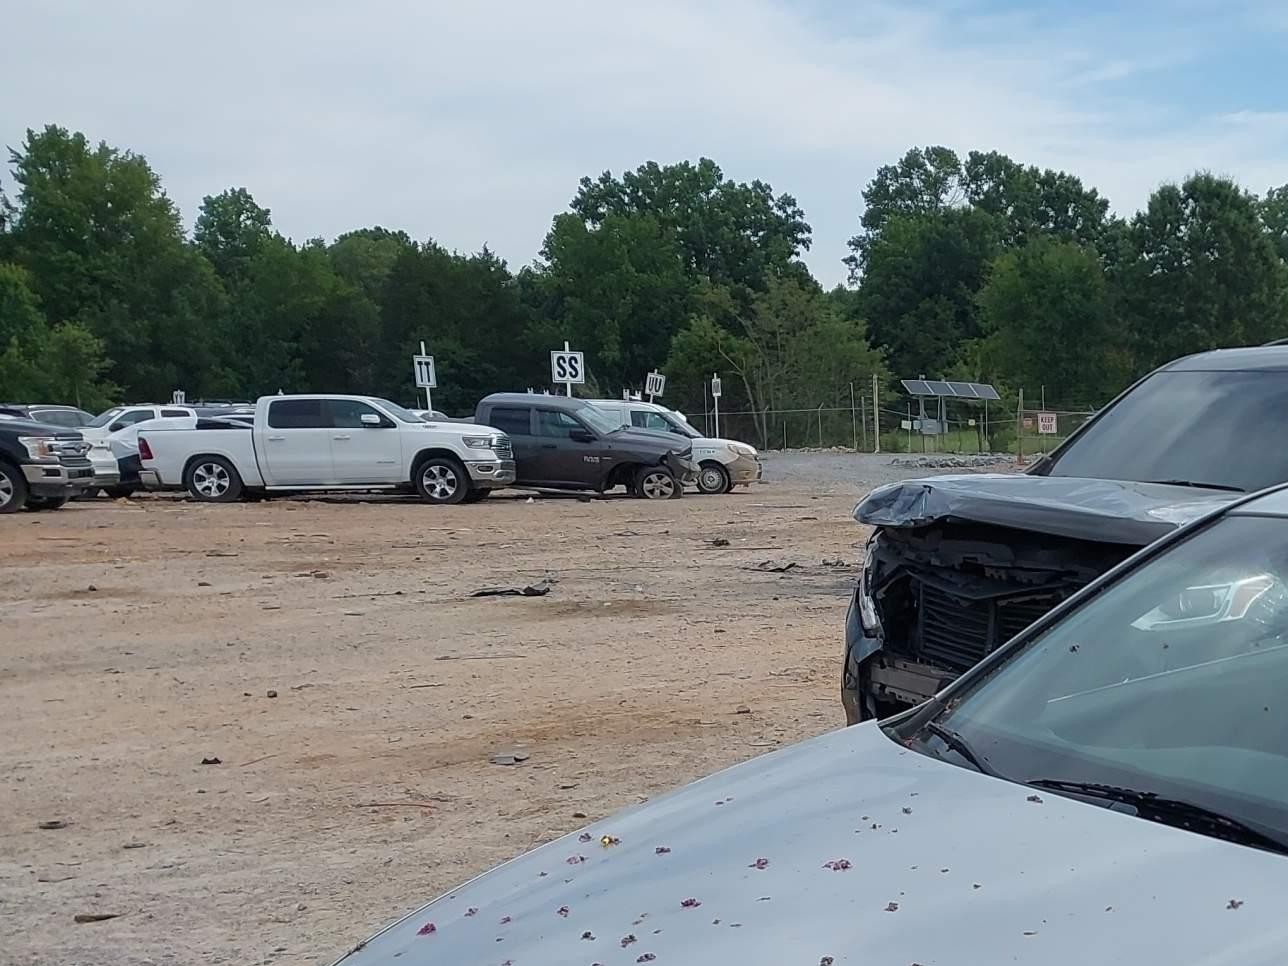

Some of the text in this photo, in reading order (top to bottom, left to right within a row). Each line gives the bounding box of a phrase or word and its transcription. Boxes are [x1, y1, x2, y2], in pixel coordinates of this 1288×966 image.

[416, 360, 431, 383] TT
[556, 355, 579, 379] SS
[648, 376, 663, 393] UU
